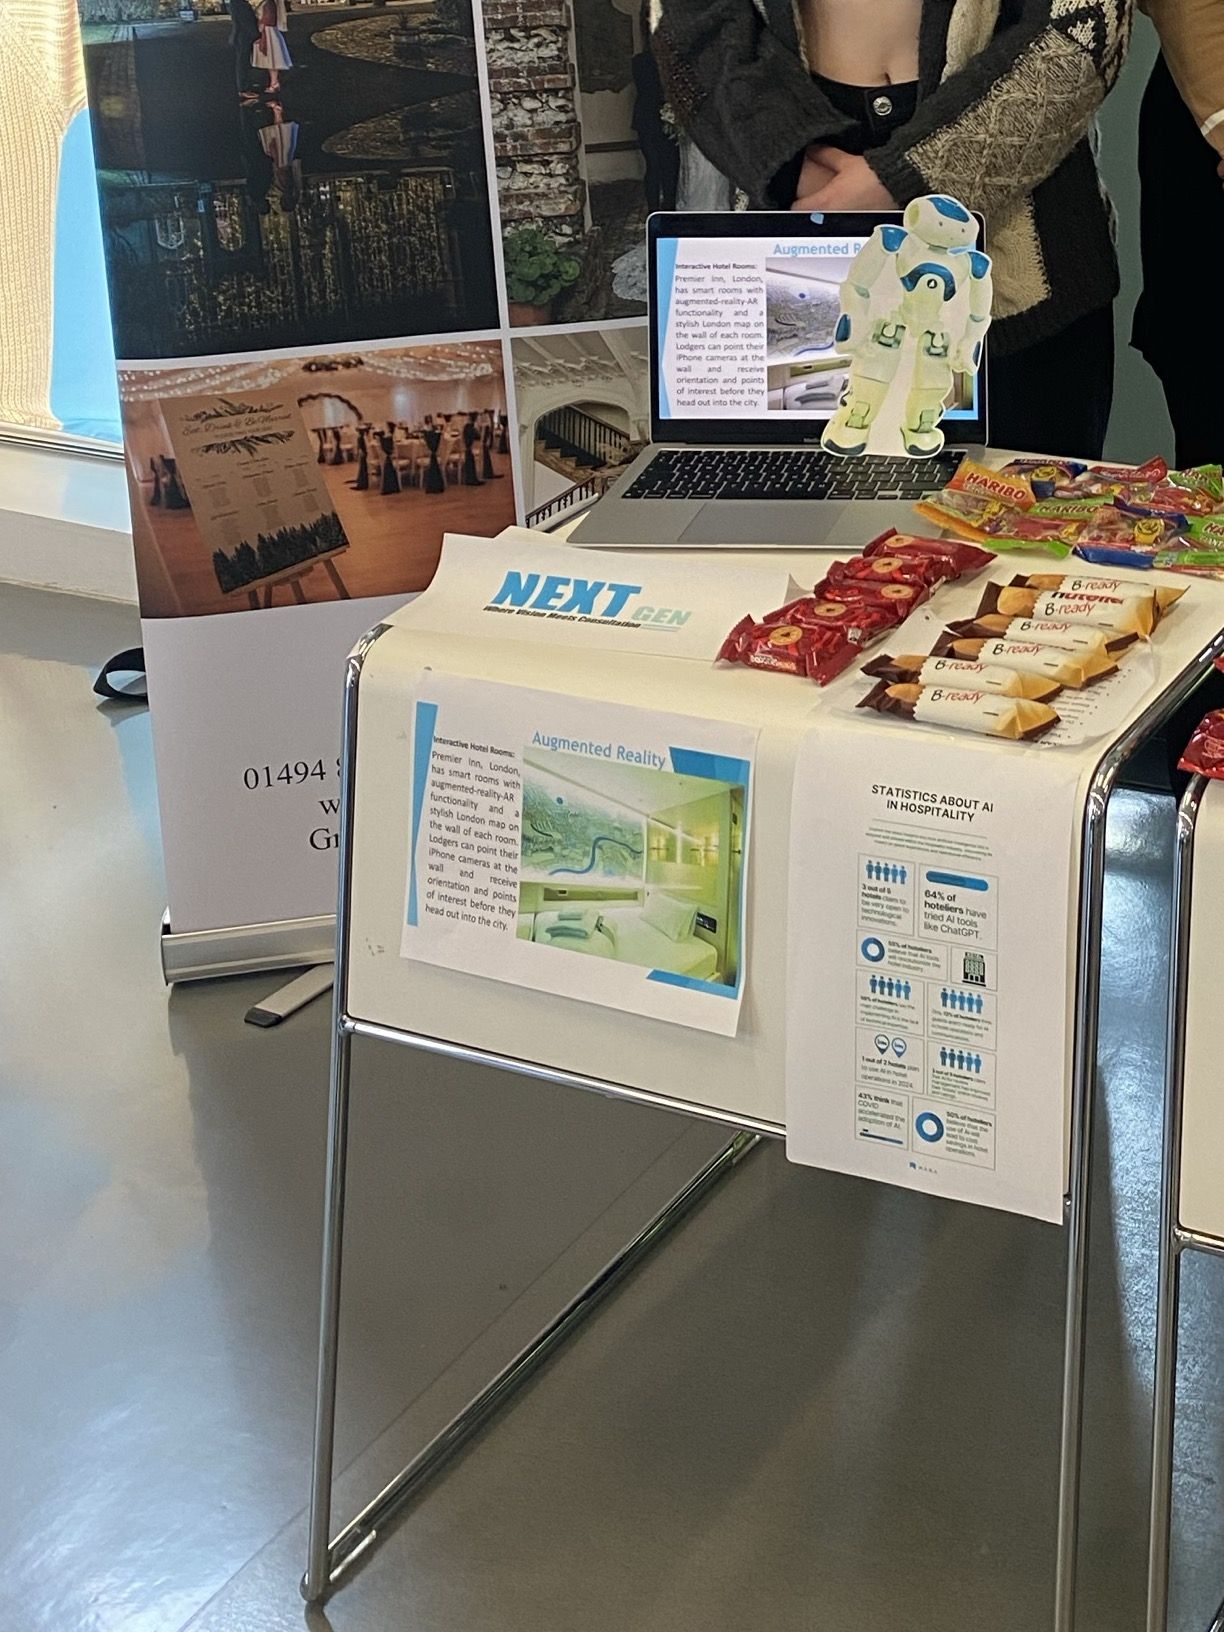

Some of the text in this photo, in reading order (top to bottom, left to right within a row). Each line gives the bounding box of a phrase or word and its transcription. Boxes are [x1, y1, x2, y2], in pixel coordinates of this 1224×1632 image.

[773, 244, 848, 257] Augmented
[733, 275, 763, 283] London,
[676, 343, 705, 351] Lodgers
[724, 343, 743, 351] point
[965, 472, 1027, 500] HARIBO
[490, 571, 692, 625] NEXT GEN
[483, 605, 515, 614] Where
[516, 609, 547, 617] Vision
[578, 616, 641, 628] Consultation
[433, 735, 515, 758] Interactive Hotel Rooms:
[532, 730, 666, 770] Augmented Reality
[243, 759, 326, 790] 01494
[432, 751, 520, 777] Premier London,
[431, 765, 520, 789] has smart rooms with
[431, 779, 514, 802] augmented-reality-AR
[872, 784, 994, 812] STATISTICS ABOUT AI
[431, 792, 478, 811] functionality
[489, 805, 503, 814] and
[886, 800, 975, 822] IN HOSPITALITY
[430, 807, 519, 832] stylish London map on
[430, 821, 518, 846] the wall of each room.
[429, 835, 518, 859] Lodgers can point their
[429, 848, 455, 861] iPhone
[458, 855, 490, 868] cameras
[505, 864, 518, 874] the
[428, 863, 517, 888] wall and receive
[428, 877, 516, 902] orientation and points
[924, 890, 956, 902] 64% of
[427, 890, 516, 919] of interest before they
[924, 900, 986, 919] hoteliers have
[425, 904, 508, 932] head out into the city.
[924, 912, 978, 928] tried AI tools
[924, 922, 982, 940] like ChatGPT.
[858, 1100, 879, 1109] COVID
[874, 1096, 890, 1104] think
